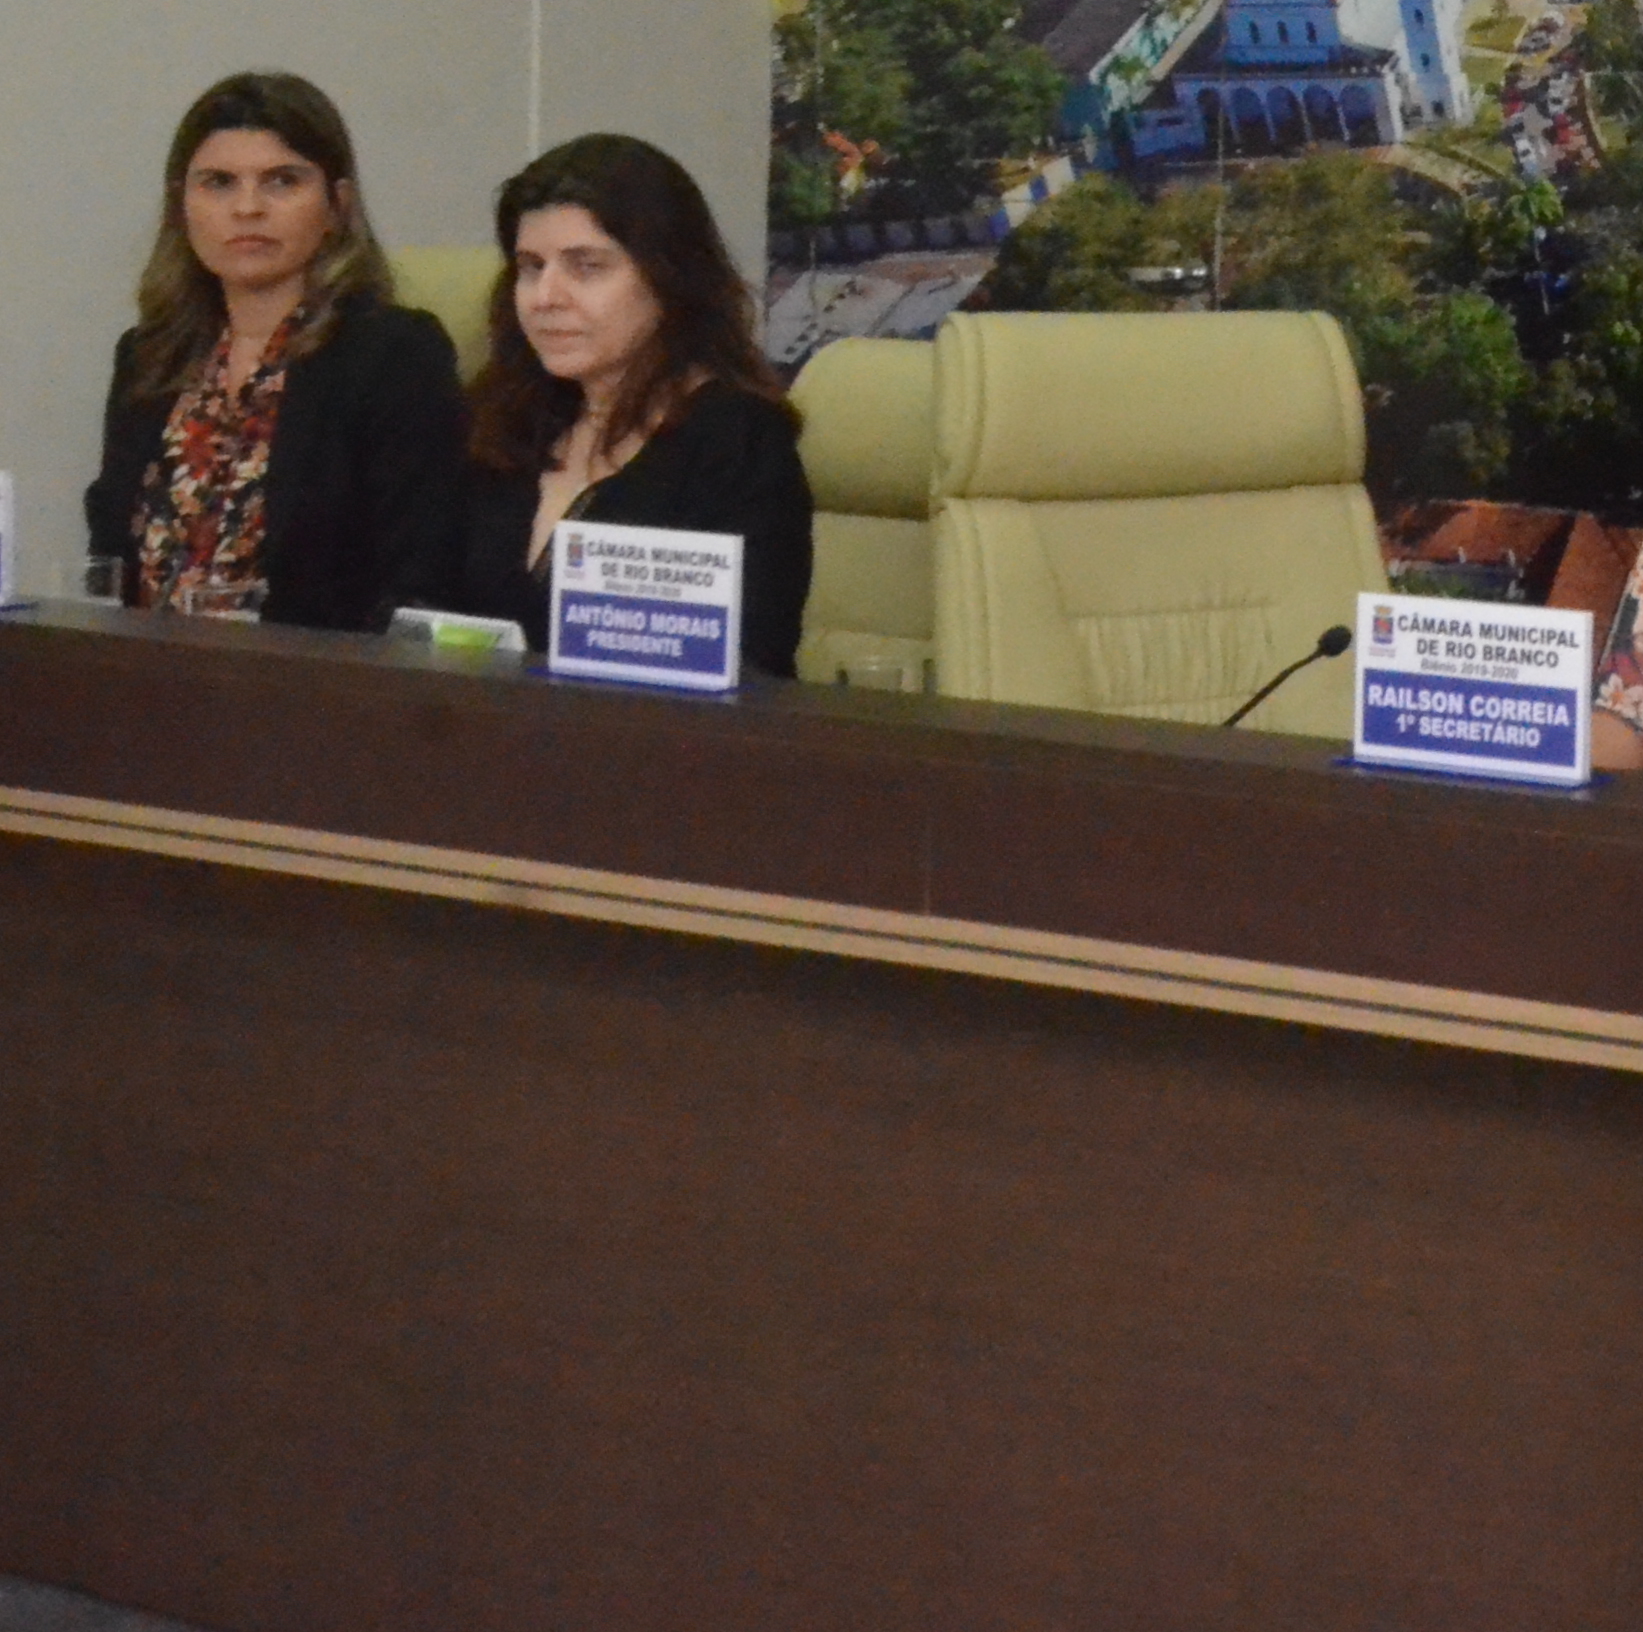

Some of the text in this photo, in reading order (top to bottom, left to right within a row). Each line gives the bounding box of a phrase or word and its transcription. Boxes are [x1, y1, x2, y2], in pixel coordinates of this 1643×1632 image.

[651, 548, 730, 570] MUNICIPAL
[653, 567, 715, 588] BRANCO
[1398, 612, 1580, 649] CÂMARA MUNICIPAL
[1416, 638, 1438, 656] DE
[1445, 640, 1476, 660] RIO
[1482, 644, 1560, 669] BRANCO
[1367, 684, 1571, 727] RAILSON CORREIA
[1419, 714, 1541, 749] SECRETÁRIO
